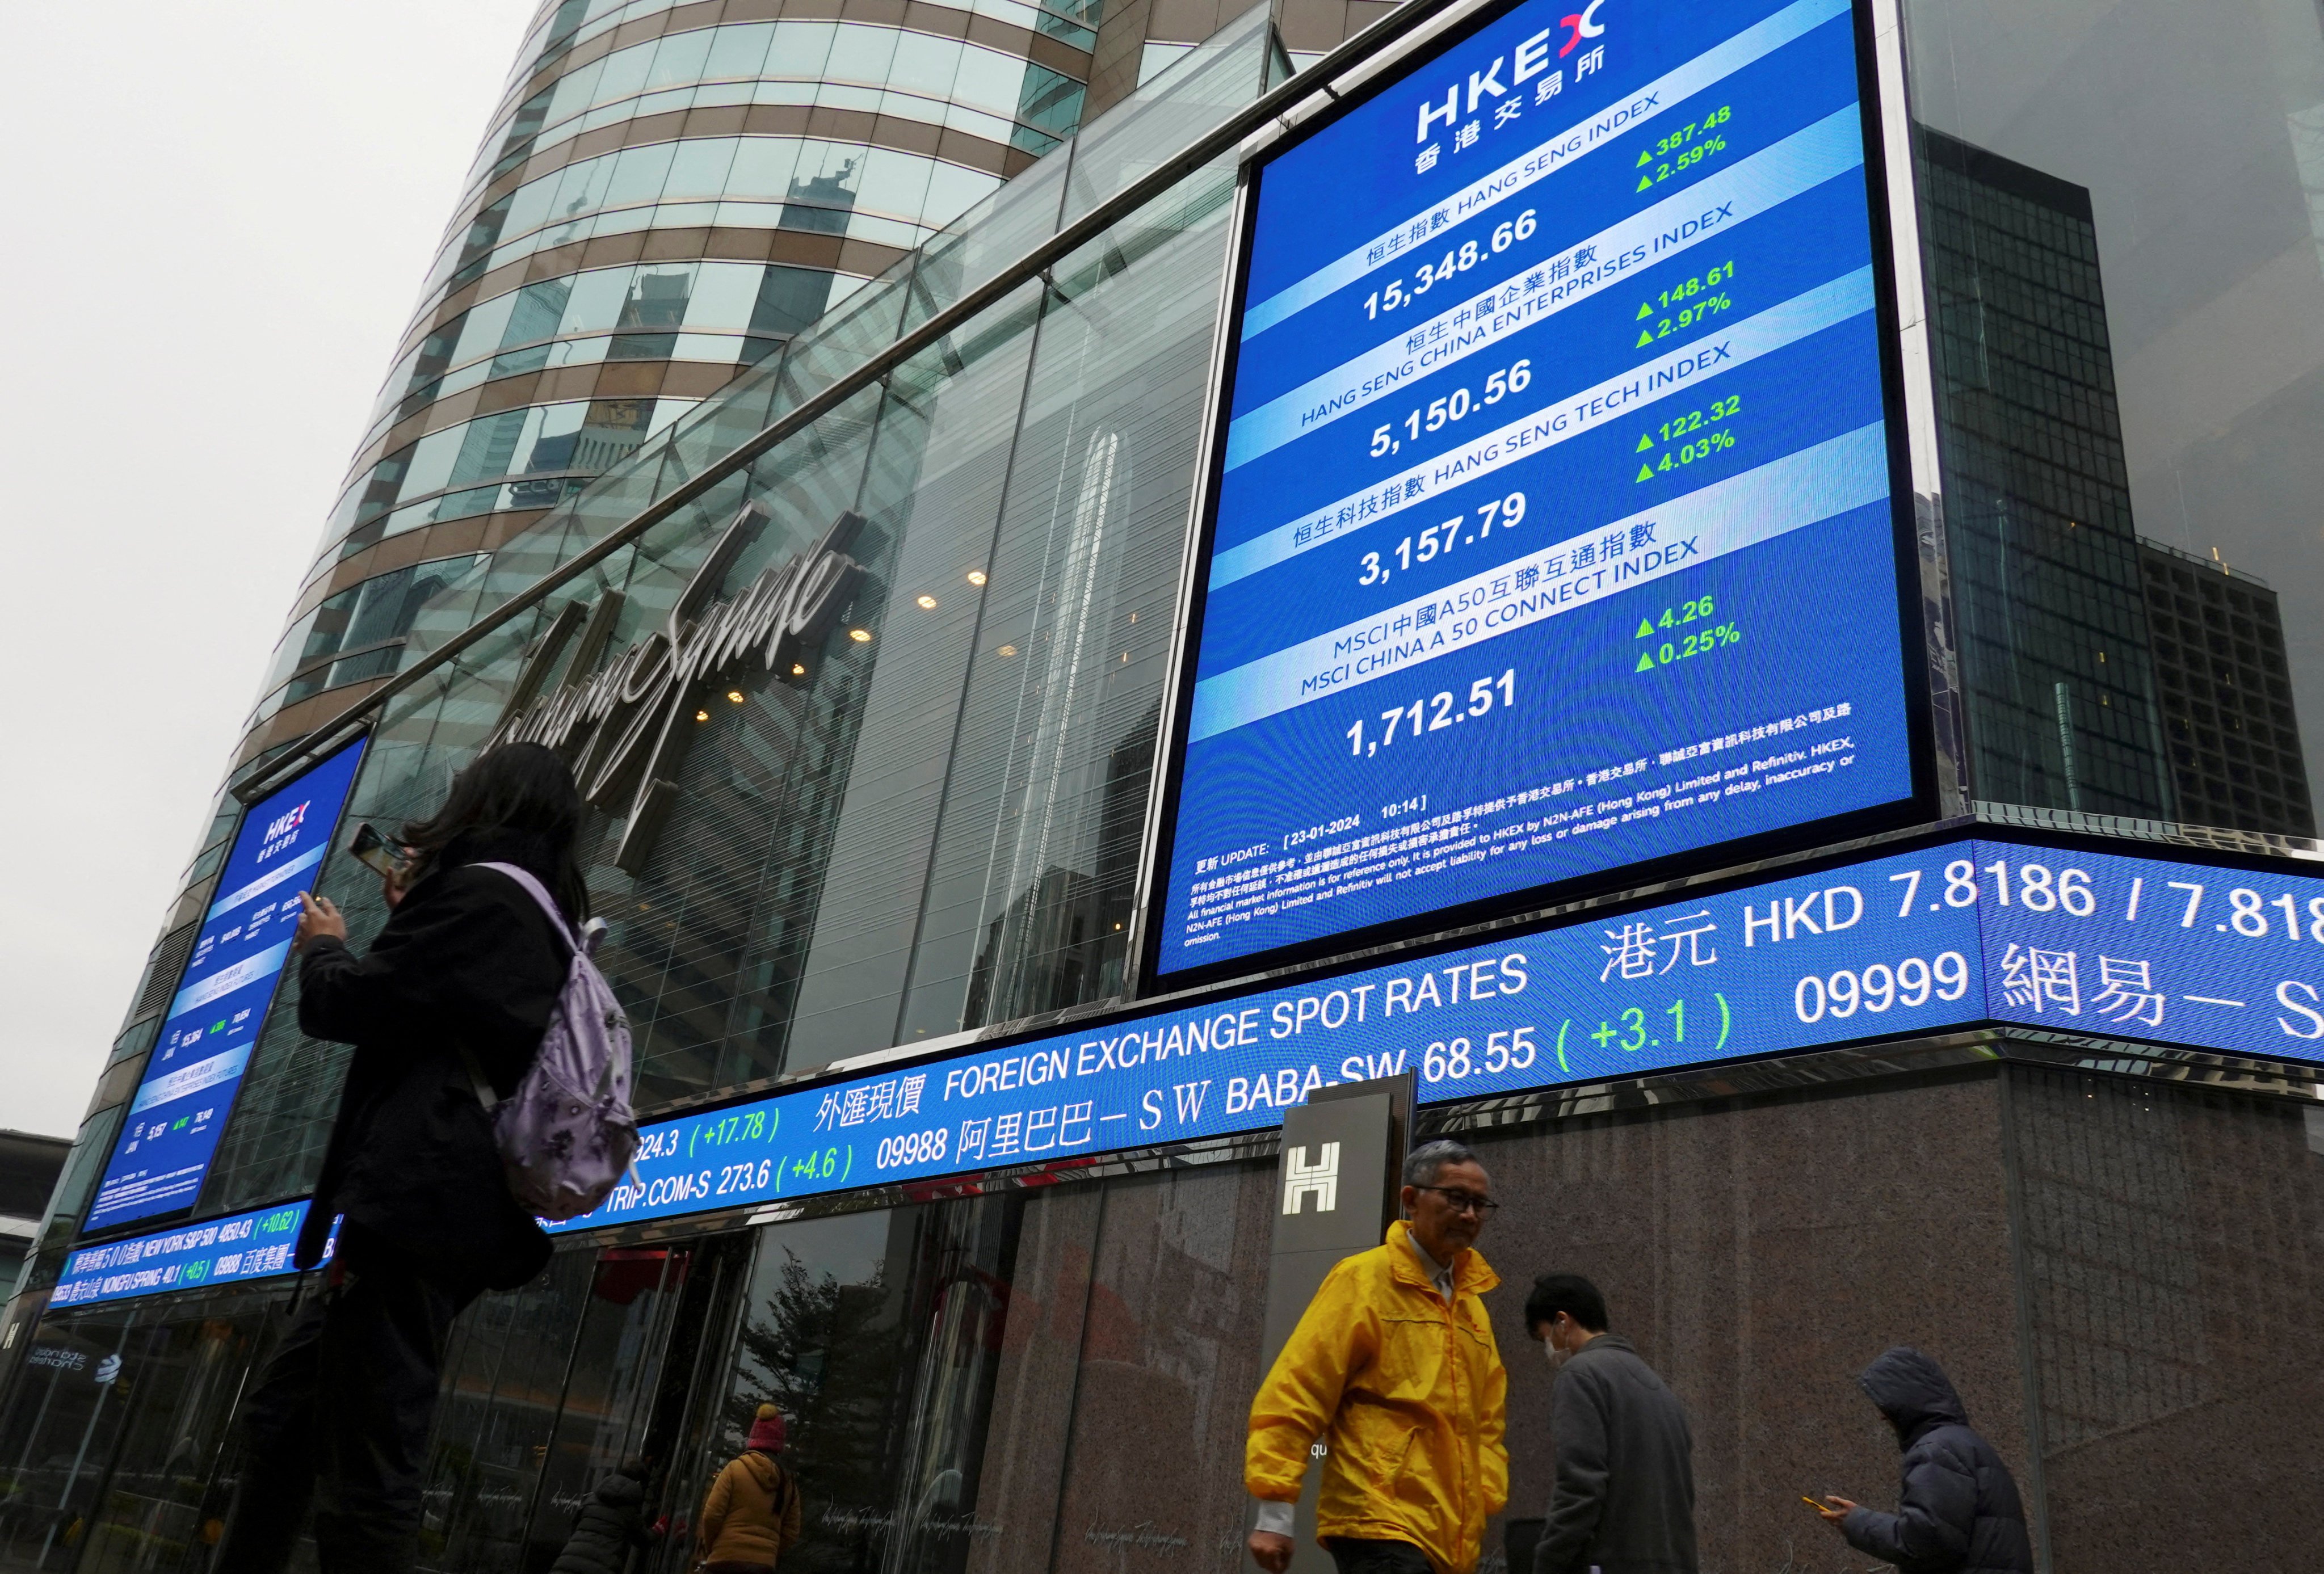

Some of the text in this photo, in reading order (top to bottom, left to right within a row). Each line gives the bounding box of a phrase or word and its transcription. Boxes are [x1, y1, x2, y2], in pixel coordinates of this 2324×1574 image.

[1415, 45, 1604, 174] 香港交易所
[1416, 0, 1608, 143] HKEX
[1655, 106, 1731, 156] 387.48
[1657, 136, 1726, 184] 2.59%
[1367, 91, 1660, 267] 恒生指數 HANG SENG INDEX
[1364, 209, 1537, 321] 15,348.66
[1406, 245, 1598, 355] 恒生中國企業指數
[1658, 260, 1735, 311] 148.61
[1302, 200, 1734, 427] HANG SENG CHINA ENTERPRISES INDEX
[1657, 293, 1732, 339] 2.97%
[1294, 340, 1732, 549] 恒生科技指數 HANG SENG TECH INDEX
[1369, 359, 1531, 458] 5,150.56
[1657, 394, 1741, 443] 122.32
[1657, 429, 1736, 473] 4.03%
[1359, 491, 1527, 587] 3,157.79
[1301, 536, 1700, 696] MSCI CHINA A 50 CONNECT INDEX
[1657, 595, 1714, 629] 4.26
[1659, 623, 1741, 665] 0.25%
[1346, 668, 1515, 758] 1,712.51
[263, 800, 310, 844] HKEX
[1186, 916, 1222, 933] N2N-AFE
[1225, 910, 1251, 925] (Hong
[1254, 902, 1278, 917] Kong)
[1282, 893, 1313, 910] Limited
[1317, 888, 1333, 900] and
[1336, 879, 1373, 896] Refinitiv
[1376, 873, 1392, 885] will
[1396, 869, 1411, 879] not
[1415, 859, 1447, 876] accept
[1450, 849, 1486, 866] liability
[1490, 844, 1504, 856] for
[1508, 839, 1527, 851] any
[1531, 832, 1552, 845] loss
[1556, 828, 1568, 839] or
[1572, 816, 1617, 835] damage
[1621, 805, 1659, 822] arising
[1664, 797, 1693, 811] from
[1698, 790, 1720, 803] any
[1766, 760, 1835, 785] inaccuracy
[1840, 755, 1855, 766] or
[1187, 911, 1199, 920] All
[1201, 903, 1233, 918] financial
[1235, 895, 1264, 908] market
[1267, 880, 1316, 900] information
[1319, 877, 1326, 886] is
[1328, 873, 1340, 884] for
[1344, 861, 1386, 879] reference
[1413, 852, 1420, 861] It
[1433, 836, 1476, 858] provided
[1480, 834, 1490, 843] to
[1494, 823, 1523, 840] HKEX
[1527, 821, 1540, 832] by
[1544, 805, 1594, 827] N2N-AFE
[1597, 797, 1633, 814] (Hong
[1637, 784, 1671, 802] Kong)
[1675, 771, 1720, 792] Limited
[1724, 764, 1748, 780] and
[1195, 856, 1218, 874] 更新
[1221, 843, 1270, 866] UPDATE:
[1184, 932, 1220, 947] omission.
[813, 1073, 926, 1132] 外匯現價
[945, 1047, 1071, 1101] FOREIGN
[1077, 1008, 1261, 1076] EXCHANGE
[1270, 985, 1375, 1039] SPOT
[1385, 953, 1528, 1017] RATES
[1599, 910, 1717, 983] 港元
[1745, 886, 1863, 948] HKD
[1889, 859, 2095, 918] 7.8186
[607, 1169, 709, 1213] TRIP.COM-S
[717, 1159, 770, 1195] 273.6
[877, 1127, 947, 1169] 09988
[1423, 1026, 1536, 1083] 68.55
[1795, 951, 1968, 1024] 09999
[101, 1274, 133, 1293] NONGFU
[131, 1268, 163, 1289] SPRING
[142, 1239, 164, 1257] NEW
[161, 1234, 186, 1255] YORK
[183, 1230, 201, 1250] S&P
[200, 1226, 218, 1247] 500
